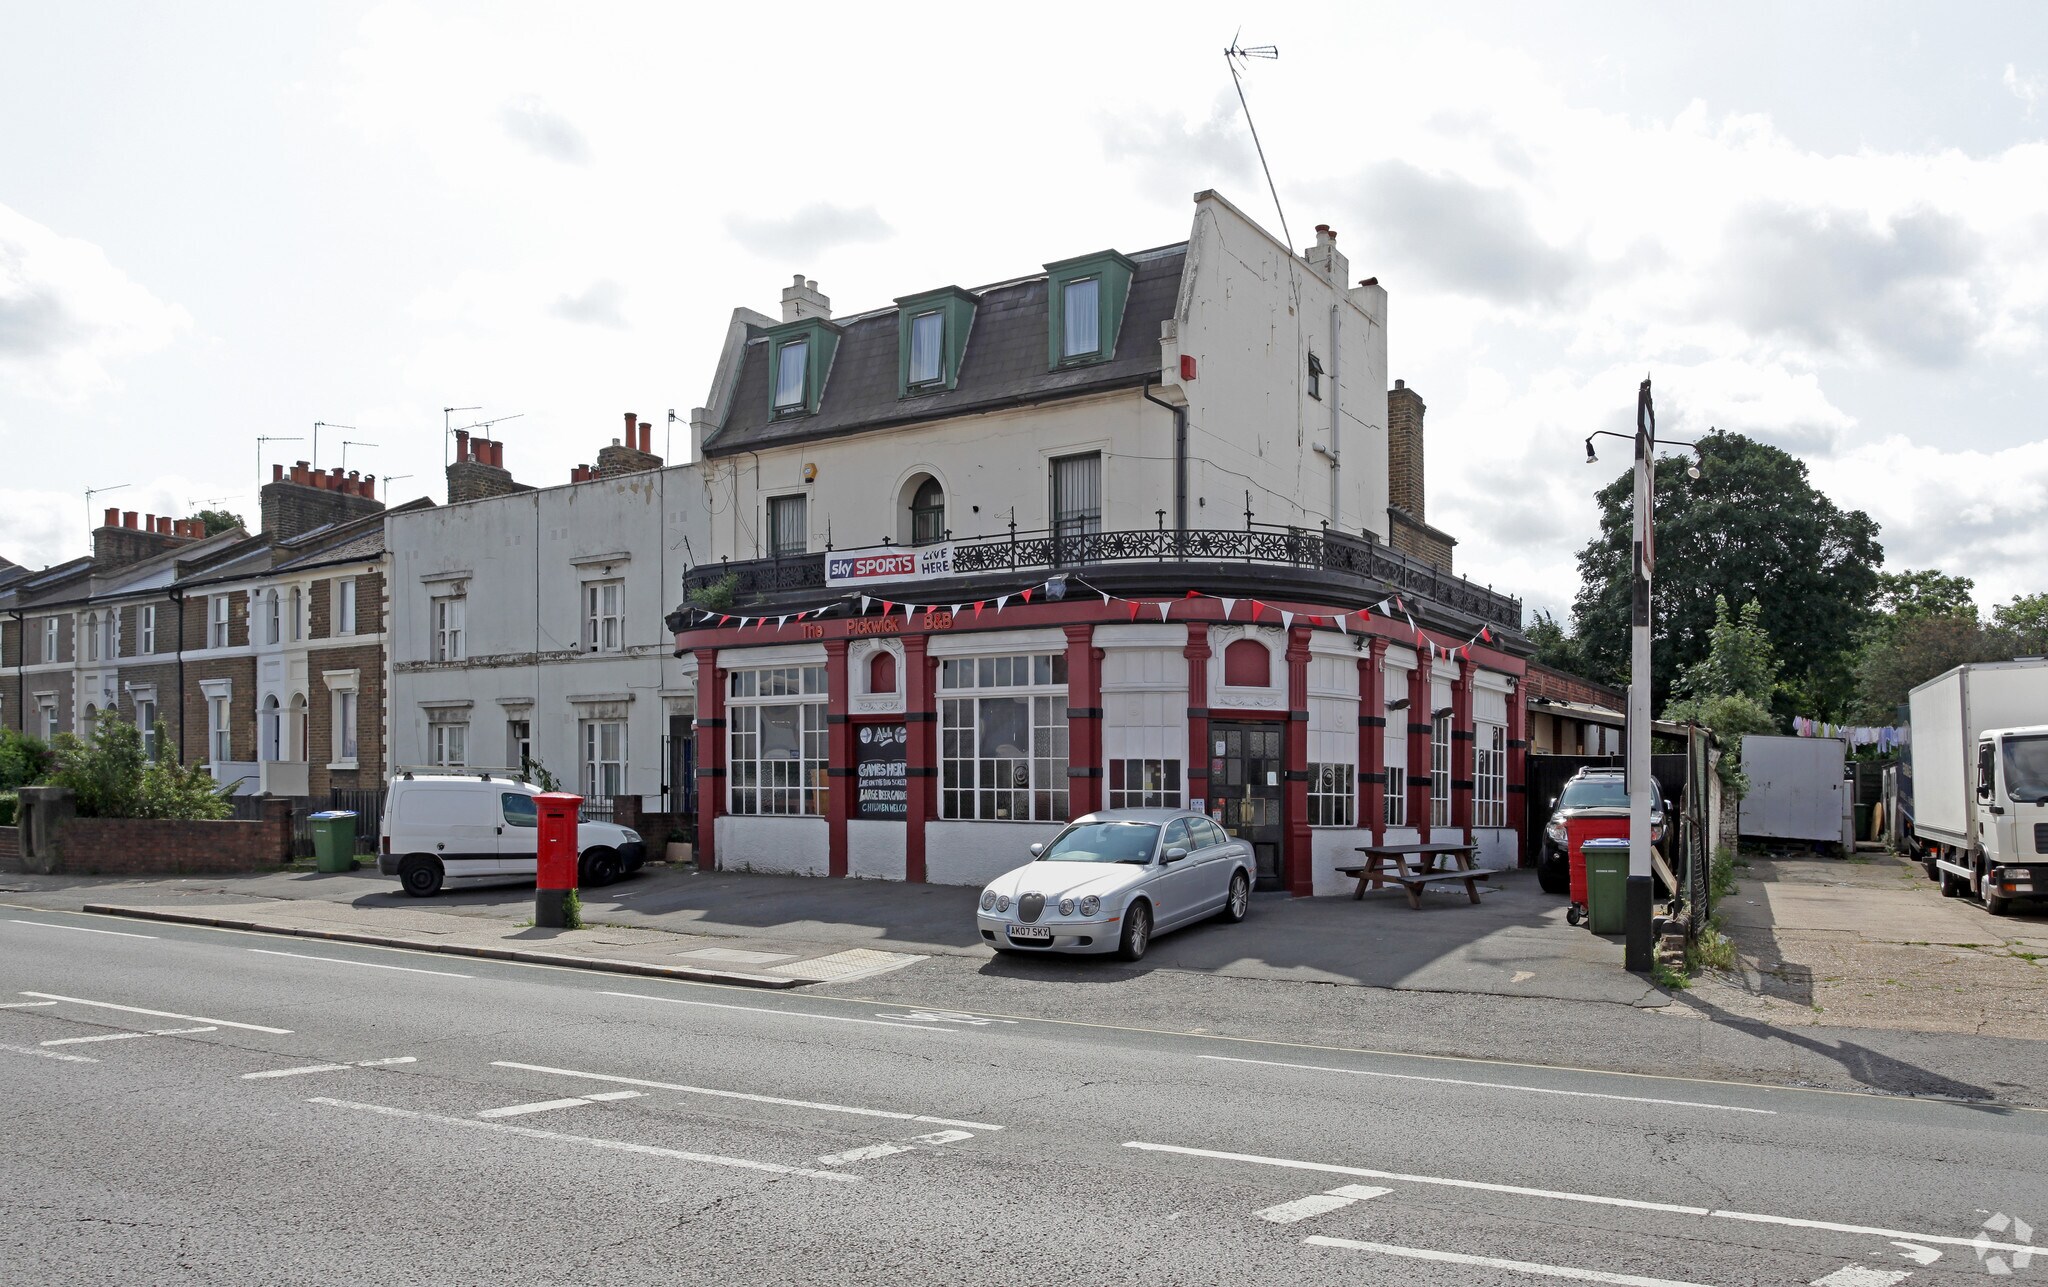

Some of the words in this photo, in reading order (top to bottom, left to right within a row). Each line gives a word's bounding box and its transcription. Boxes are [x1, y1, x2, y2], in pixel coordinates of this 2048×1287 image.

[922, 547, 947, 560] LIVE
[831, 561, 853, 577] sky
[856, 555, 912, 575] SPORTS
[921, 560, 949, 574] HERE
[801, 623, 823, 638] The
[846, 615, 898, 635] Pickwick
[923, 612, 953, 630] B&B
[873, 726, 893, 742] ALL
[858, 763, 886, 777] GAMES
[858, 789, 878, 802] LARGE
[878, 789, 891, 801] BEER
[1011, 926, 1030, 936] AK07
[1032, 928, 1048, 937] SKX
